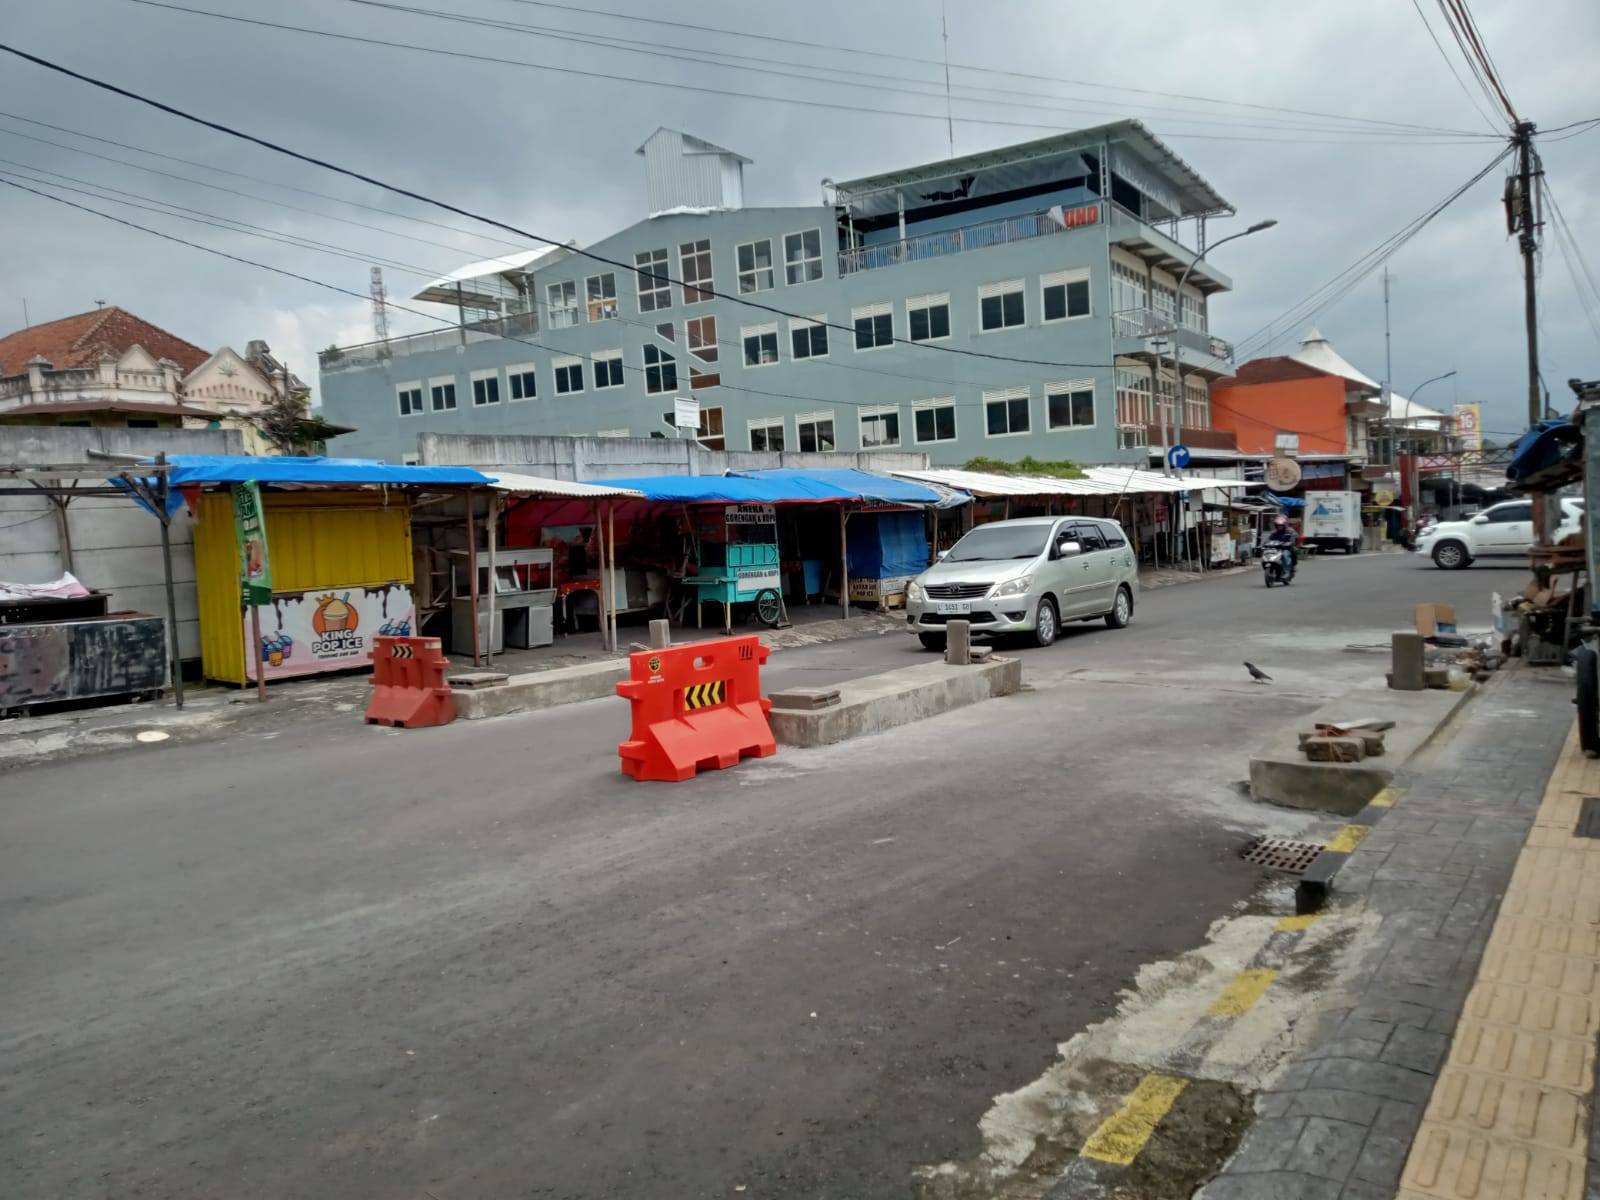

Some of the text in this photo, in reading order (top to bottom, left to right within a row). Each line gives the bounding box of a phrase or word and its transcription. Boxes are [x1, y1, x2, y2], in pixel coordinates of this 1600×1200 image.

[321, 629, 353, 641] KING
[312, 637, 363, 653] POP ICE
